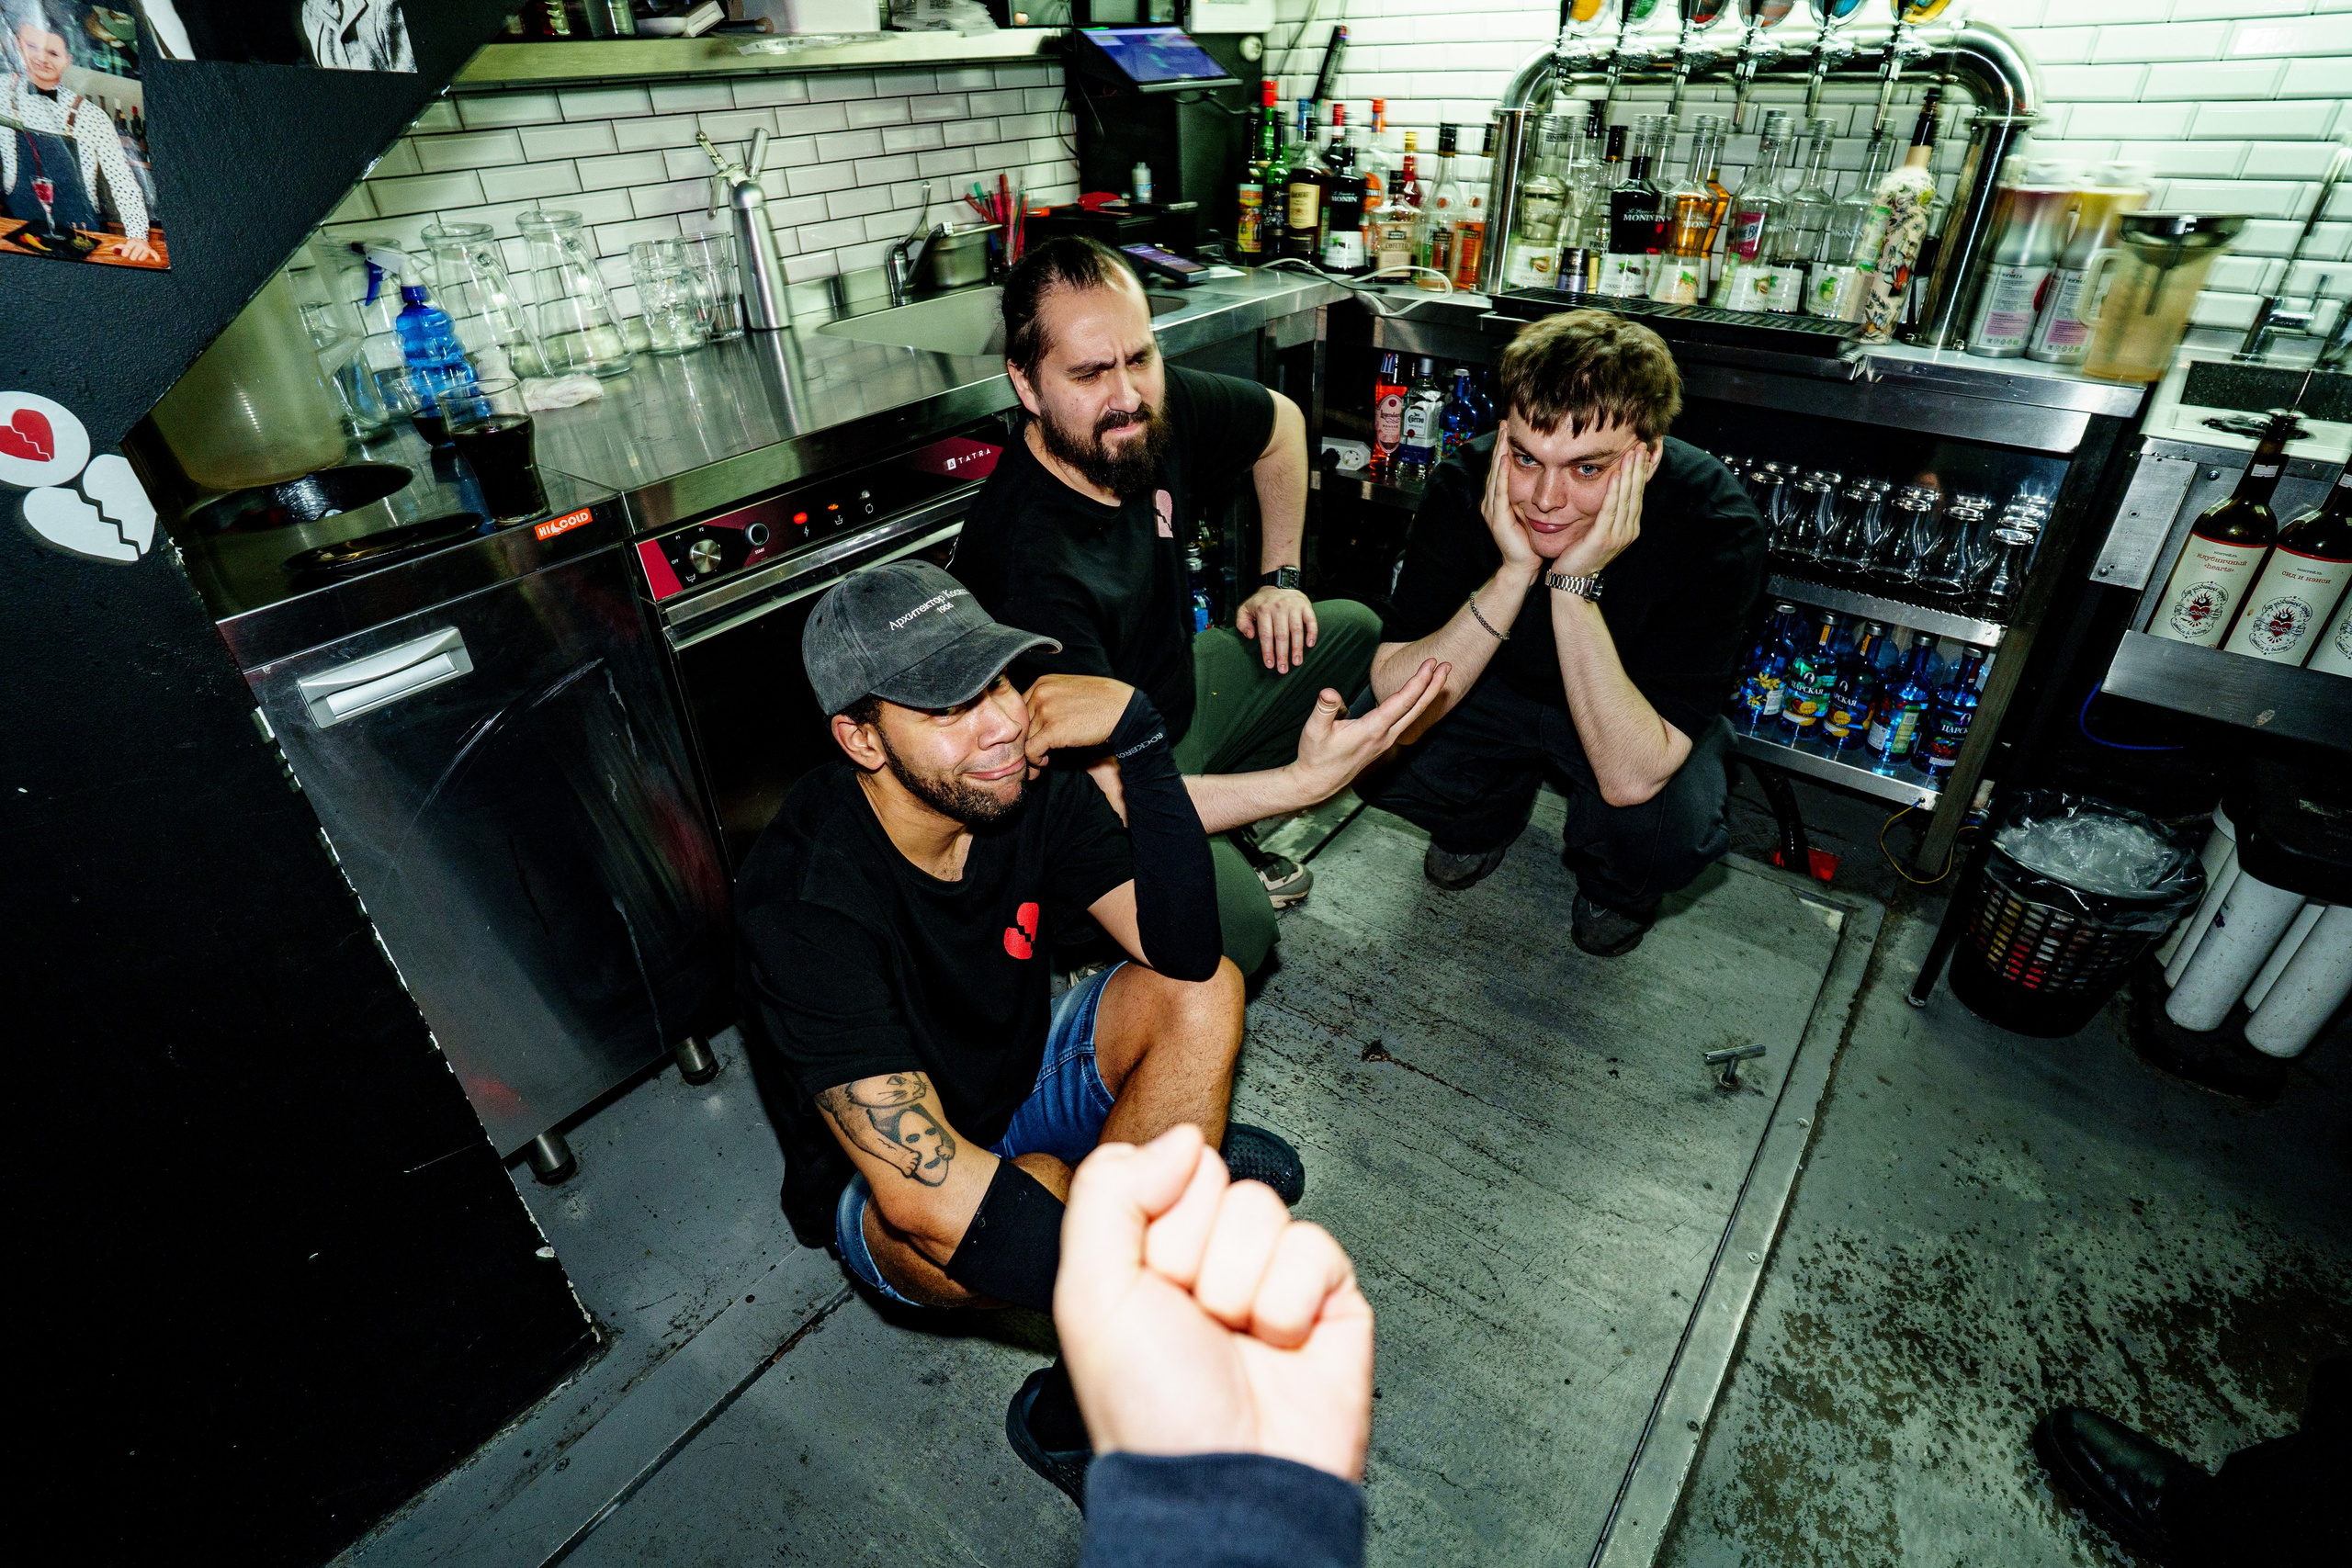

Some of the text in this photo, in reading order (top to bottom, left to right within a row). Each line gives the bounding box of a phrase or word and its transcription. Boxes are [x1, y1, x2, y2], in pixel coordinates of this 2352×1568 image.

[1830, 229, 1864, 239] MONN
[957, 447, 991, 465] TATRA
[2196, 553, 2247, 566] клубничный
[2281, 570, 2297, 580] сид
[2305, 576, 2332, 584] нэнси
[888, 594, 946, 631] Архитектор
[936, 602, 954, 614] 1906
[1791, 682, 1824, 695] ЦАРСКАЯ
[1941, 724, 1969, 734] ЦАРСК
